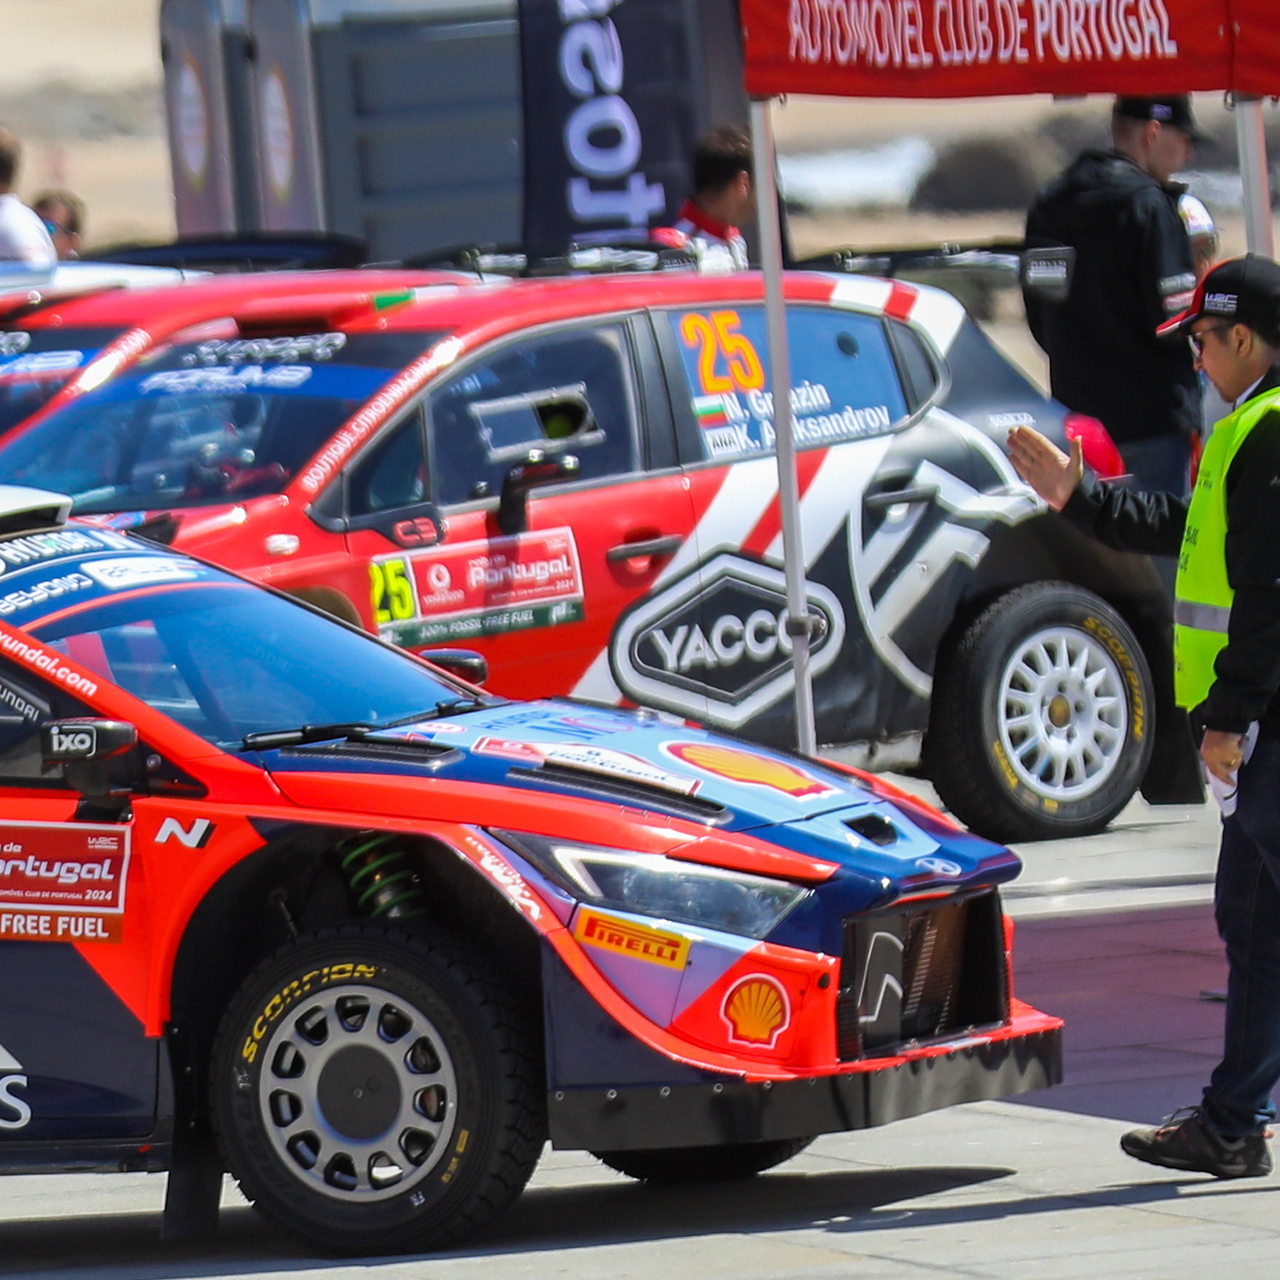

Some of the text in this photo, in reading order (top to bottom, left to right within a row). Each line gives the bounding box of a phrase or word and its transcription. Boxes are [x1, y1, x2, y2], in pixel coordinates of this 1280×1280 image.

[934, 0, 994, 66] CLUB
[997, 0, 1030, 64] DE
[1034, 0, 1178, 62] PORTUGAL
[680, 310, 766, 394] 25
[393, 519, 438, 549] C3
[468, 554, 573, 588] Portugal
[370, 558, 416, 624] 25
[2, 841, 23, 853] de
[84, 888, 113, 901] 2024
[56, 916, 109, 938] FUEL
[584, 915, 681, 961] PIRELLI
